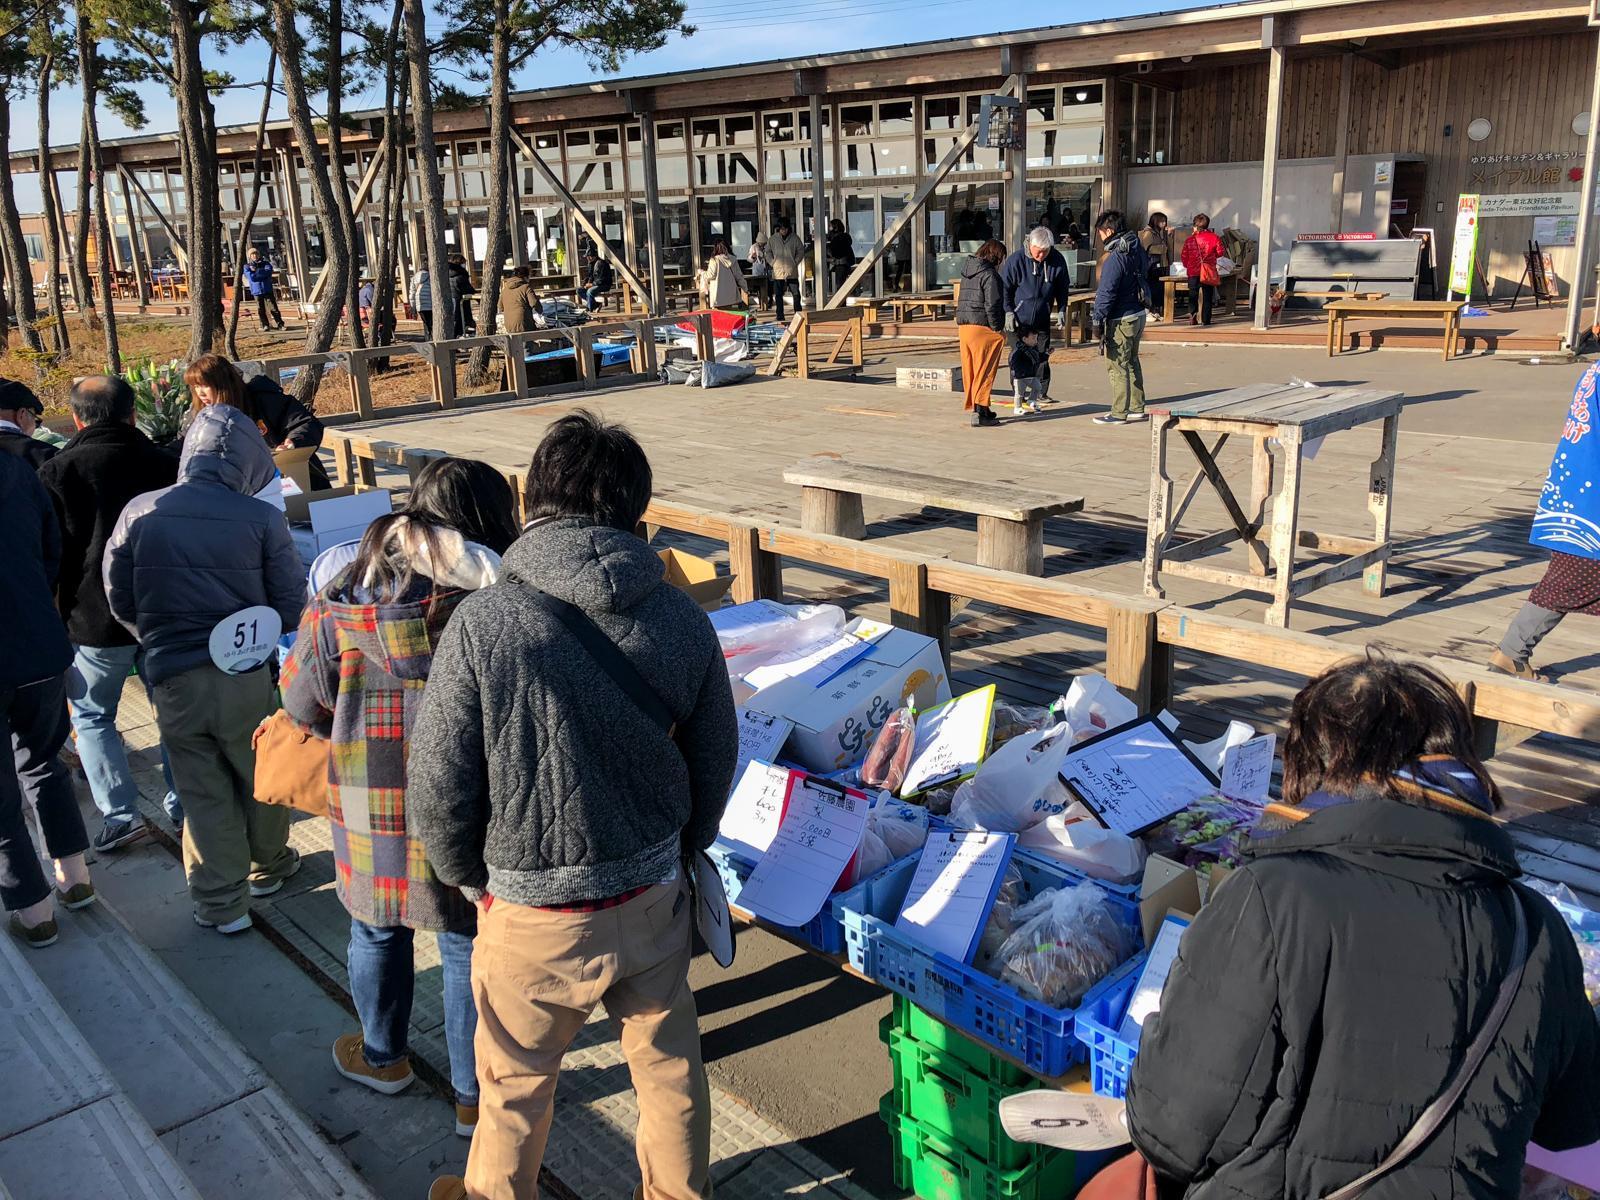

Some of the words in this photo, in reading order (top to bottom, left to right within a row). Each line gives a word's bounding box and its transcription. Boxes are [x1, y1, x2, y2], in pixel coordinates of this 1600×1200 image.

[910, 371, 938, 380] マルヒロ
[233, 619, 258, 649] 51
[838, 695, 894, 754] ピチピチ
